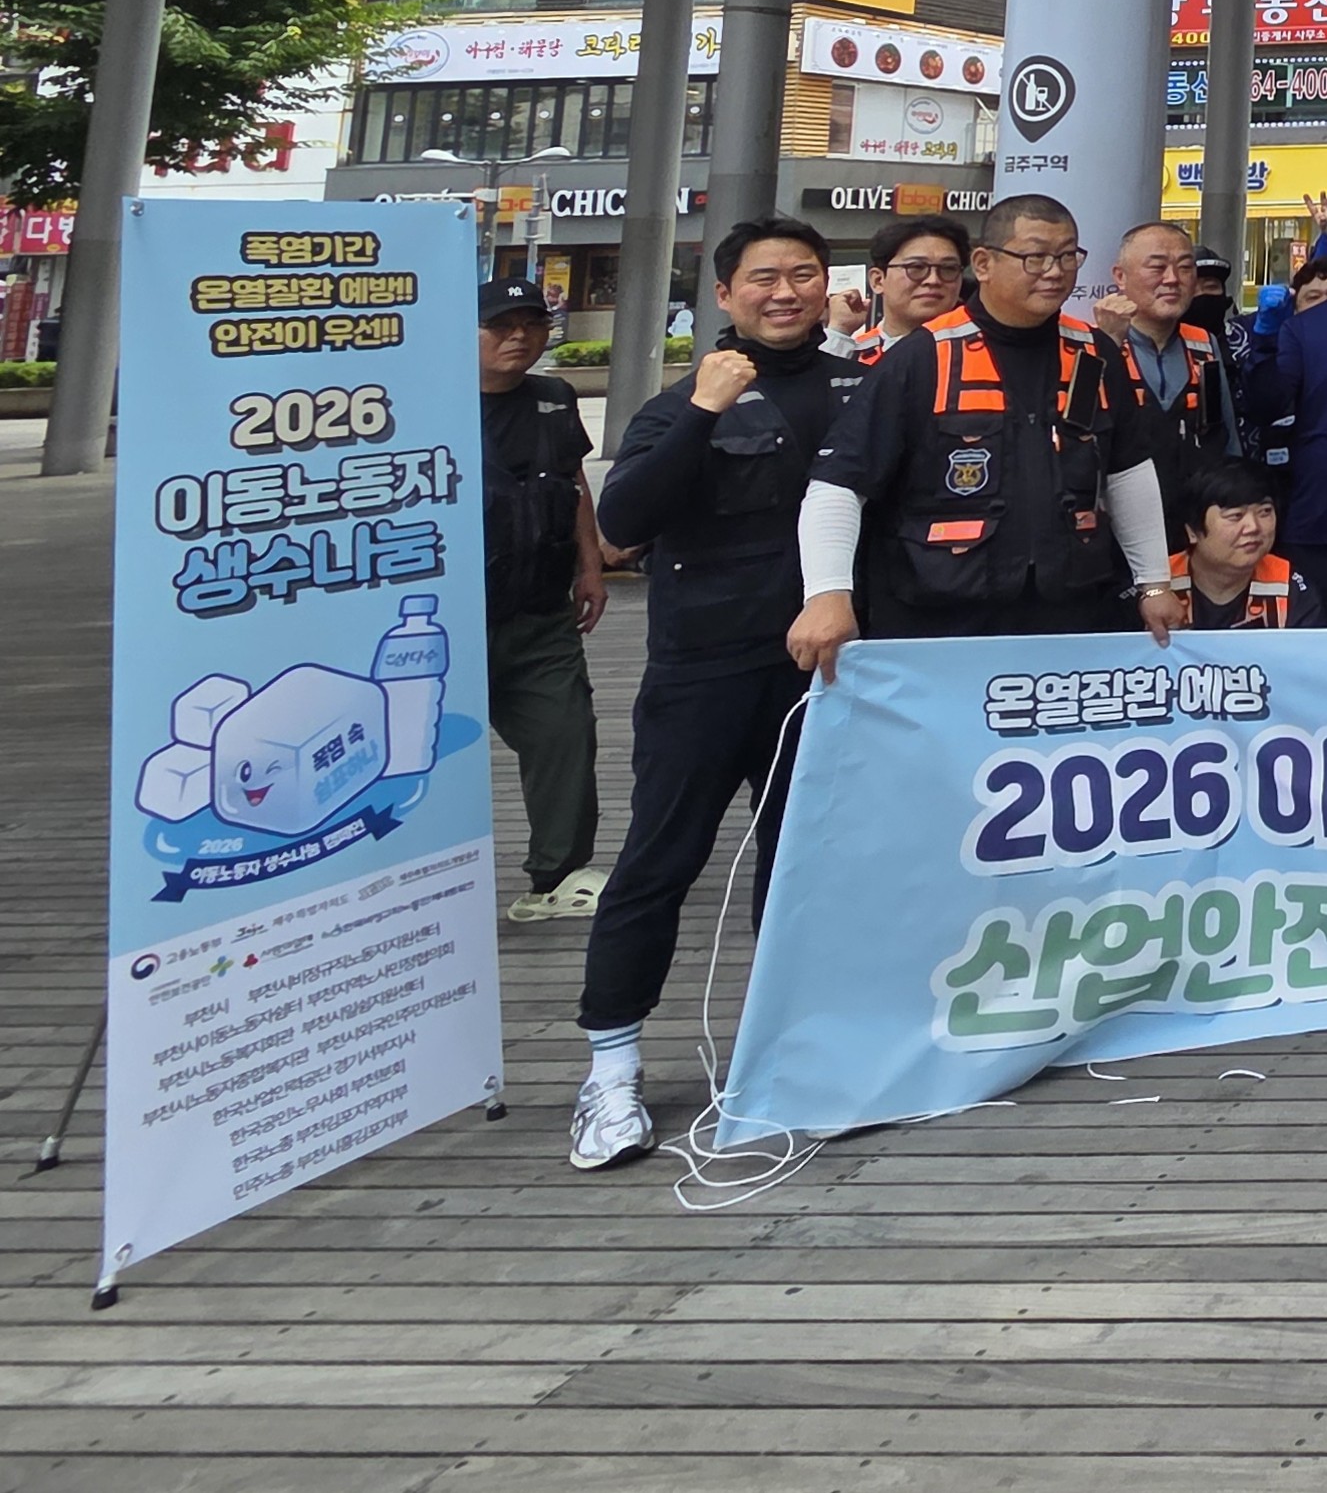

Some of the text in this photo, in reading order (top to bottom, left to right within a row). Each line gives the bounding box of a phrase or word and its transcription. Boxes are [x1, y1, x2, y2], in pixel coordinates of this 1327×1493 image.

[1005, 155, 1069, 173] 금주구역
[831, 187, 893, 210] OLIVE
[243, 234, 378, 265] 폭염기간
[194, 274, 415, 311] 온열질환 예방!!
[211, 315, 400, 354] 안전이 우선!!
[231, 386, 389, 450] 2026
[157, 447, 455, 534] 이동노동자
[174, 520, 441, 613] 생수나눔
[985, 664, 1269, 732] 온열질환 예방
[312, 722, 366, 772] 폭염 속
[974, 739, 1232, 863] 2026
[198, 837, 244, 855] 2026
[190, 859, 262, 886] 이동노동자
[184, 997, 229, 1027] 부천시
[232, 1133, 294, 1174] 한국노총
[233, 1160, 295, 1201] 민주노총
